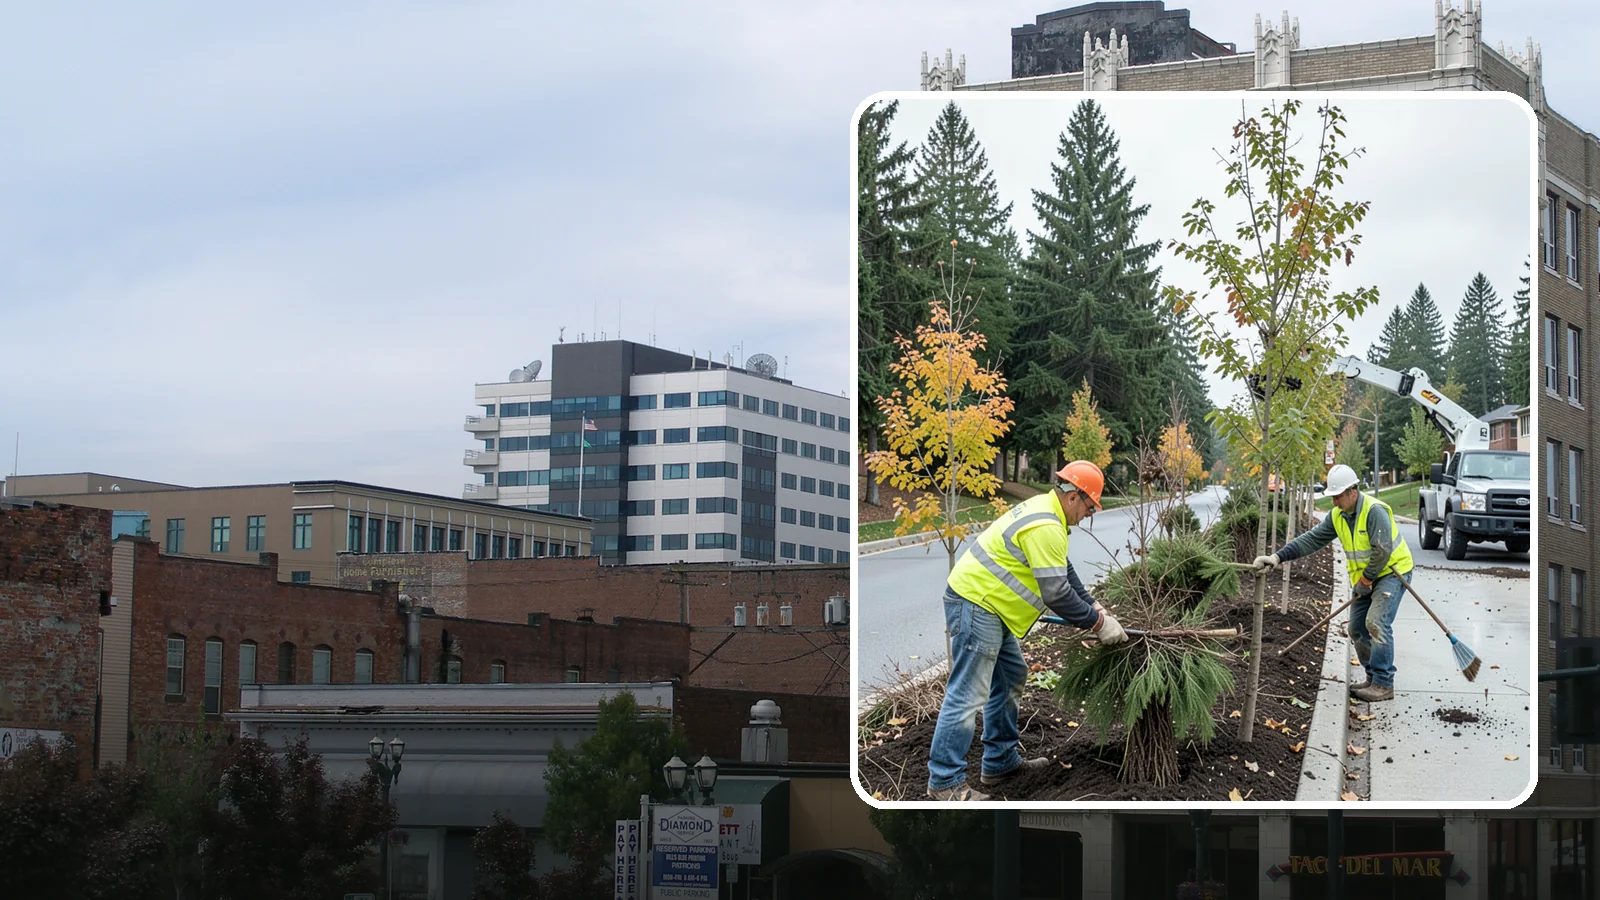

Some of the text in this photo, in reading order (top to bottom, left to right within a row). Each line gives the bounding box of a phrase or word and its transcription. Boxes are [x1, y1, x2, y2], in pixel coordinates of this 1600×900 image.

[370, 566, 427, 576] Furnishers
[660, 818, 713, 832] DIAMOND
[1021, 815, 1070, 828] BUILDING
[719, 824, 740, 835] ETT
[719, 839, 739, 848] ANT
[689, 846, 716, 854] PARKING
[616, 825, 625, 894] PAY HERE
[627, 824, 637, 894] PAY HERE
[721, 851, 739, 862] Soup
[1346, 856, 1385, 876] DEL
[1391, 857, 1442, 877] MAR
[661, 889, 710, 898] PUBLIC PARKING
